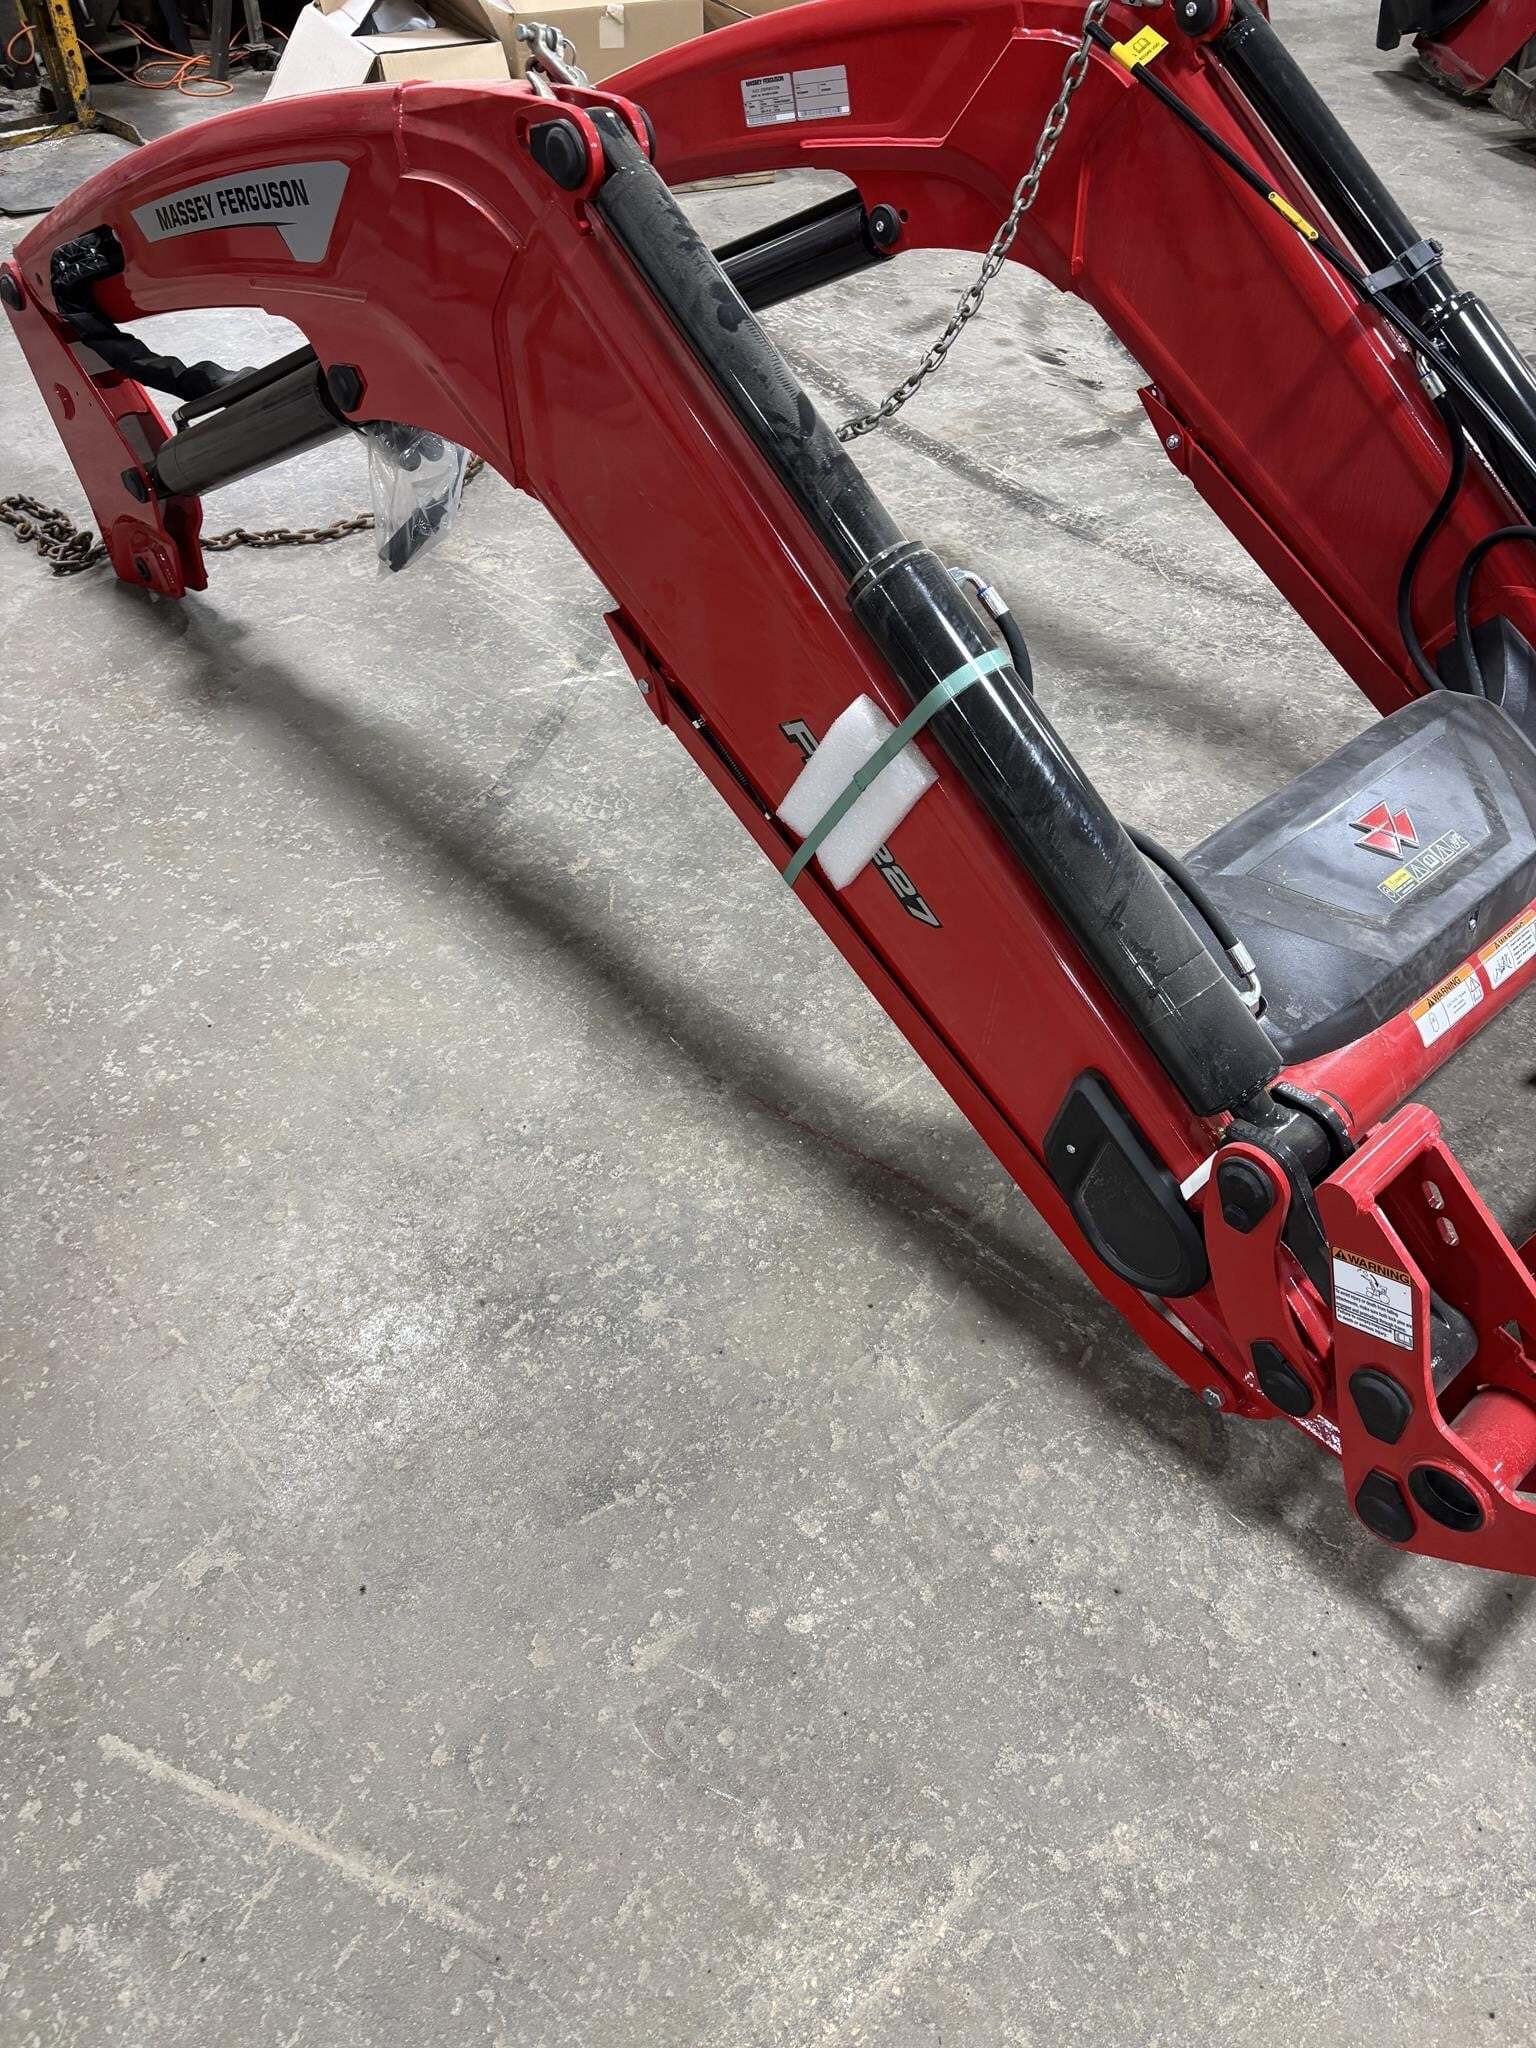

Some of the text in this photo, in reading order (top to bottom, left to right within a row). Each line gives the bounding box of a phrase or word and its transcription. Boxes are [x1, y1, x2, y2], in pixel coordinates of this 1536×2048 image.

[155, 178, 310, 231] MASSEY FERGUSON
[1430, 975, 1461, 1004] WARNING
[1346, 1253, 1410, 1285] WARNING
